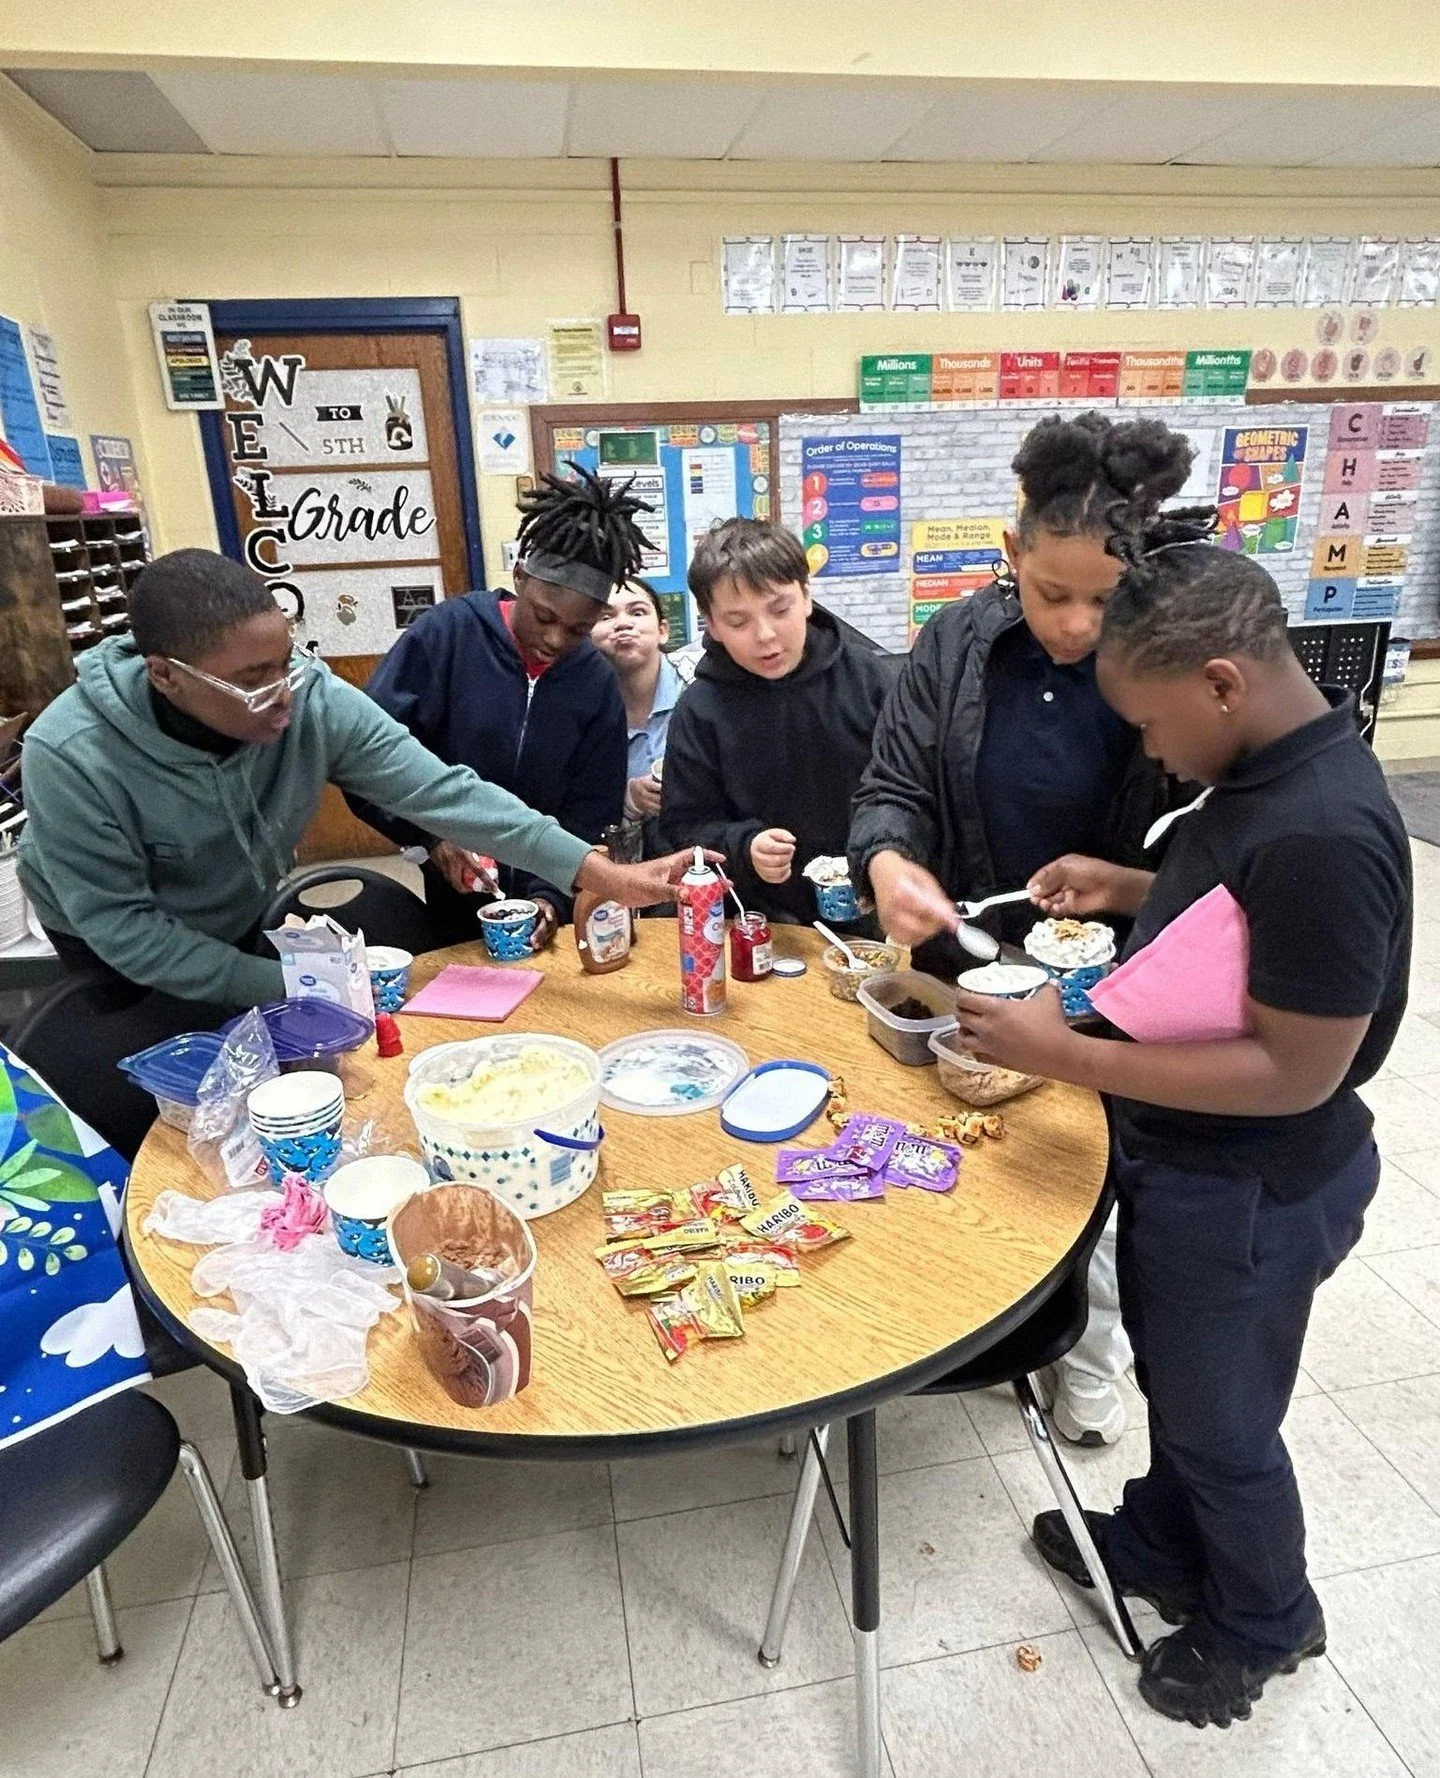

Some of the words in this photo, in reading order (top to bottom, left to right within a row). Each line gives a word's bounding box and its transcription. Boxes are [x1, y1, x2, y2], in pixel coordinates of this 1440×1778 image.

[876, 358, 917, 371] Millions
[939, 357, 992, 369] Thousands
[1016, 356, 1043, 368] Units
[1195, 354, 1242, 366] Millionths
[328, 408, 351, 419] TO
[1235, 429, 1300, 448] GEOMETRIC
[806, 444, 833, 457] Order
[835, 440, 846, 451] of
[846, 440, 898, 454] Operations
[812, 475, 820, 491] 1
[287, 485, 435, 542] Grade
[812, 500, 823, 515] 2
[812, 523, 823, 539] 3
[927, 532, 952, 541] Mode
[962, 532, 991, 540] Range
[916, 553, 943, 564] MEAN
[915, 578, 949, 588] MEDIAN
[757, 1203, 800, 1234] HARIBO
[683, 1226, 710, 1235] HARIBO
[729, 1275, 766, 1286] RIBO
